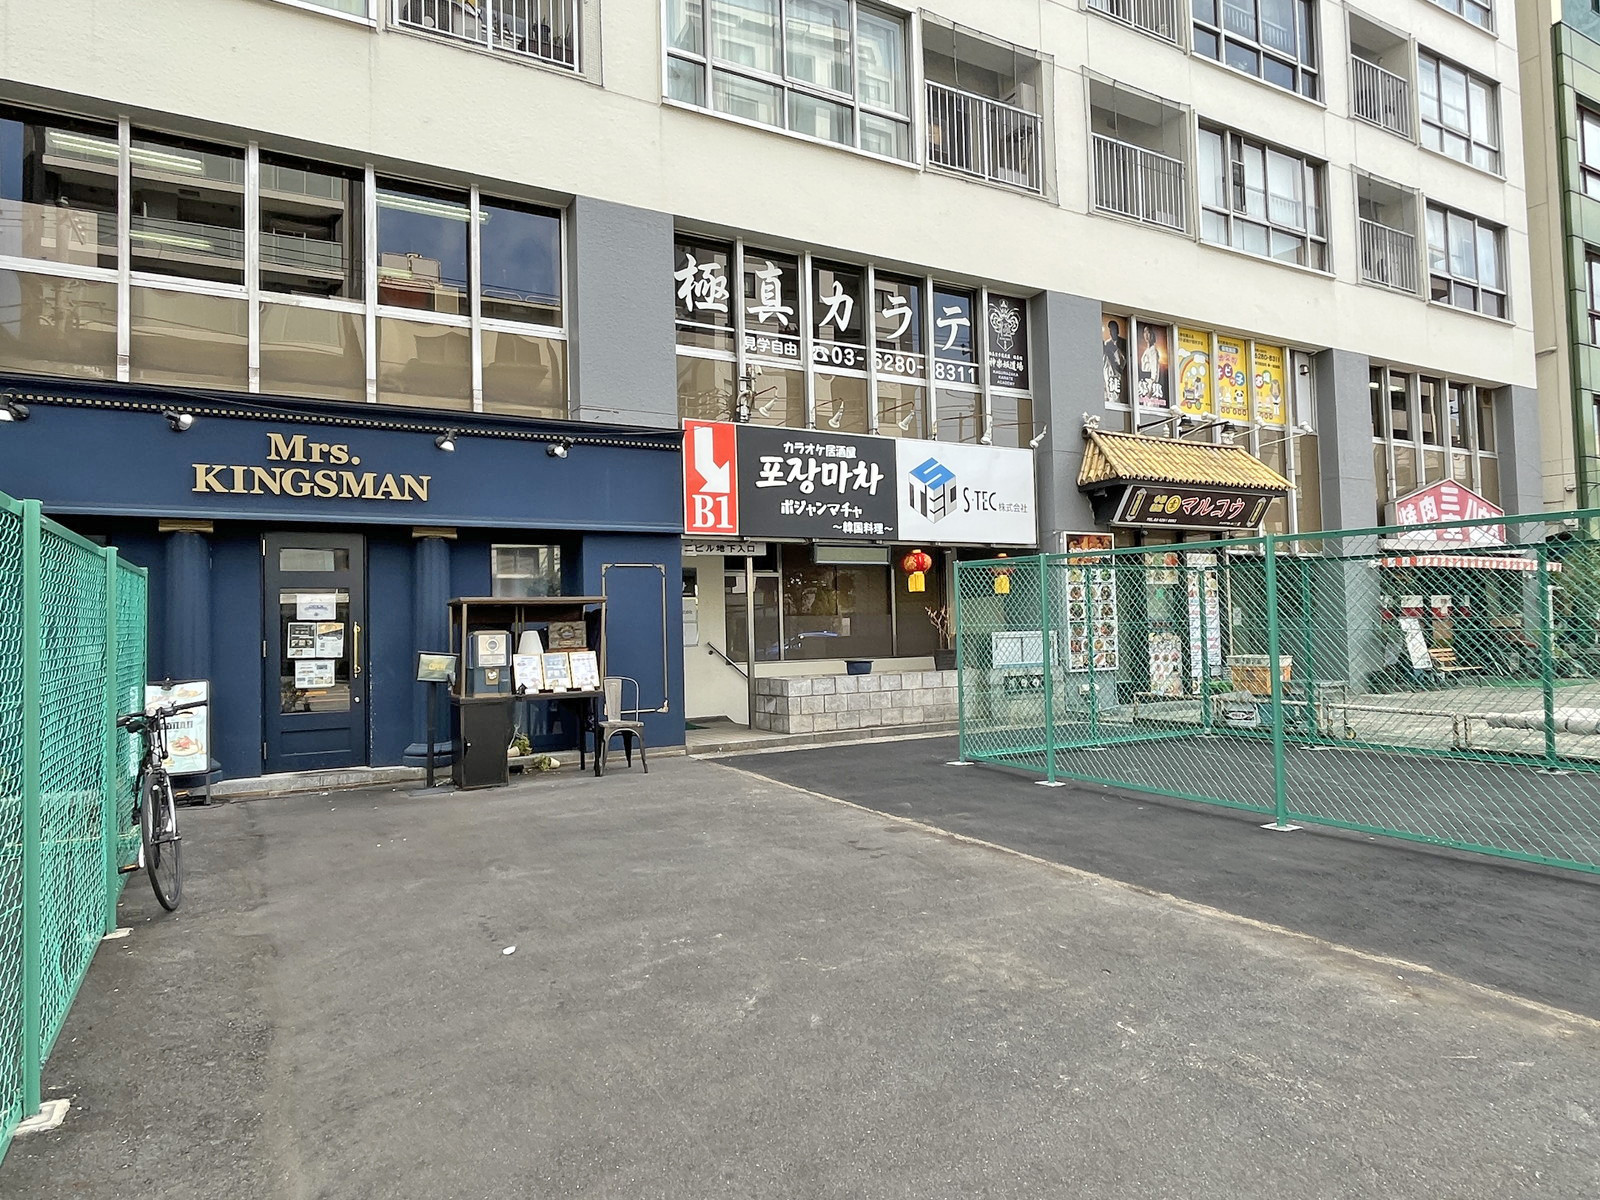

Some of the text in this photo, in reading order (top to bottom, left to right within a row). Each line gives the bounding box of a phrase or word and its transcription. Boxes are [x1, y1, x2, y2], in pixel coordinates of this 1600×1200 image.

[674, 253, 971, 351] 極真カラテ
[744, 335, 798, 356] 見学自由
[266, 432, 361, 465] Mrs.
[782, 441, 857, 459] カラオケ居酒屋
[191, 463, 432, 502] KINGSMAN
[755, 456, 885, 496] 포장마차
[692, 494, 734, 529] B1
[780, 499, 863, 519] ポジャンマチャ
[998, 503, 1028, 513] 株式会社
[1181, 496, 1246, 520] マルコウ
